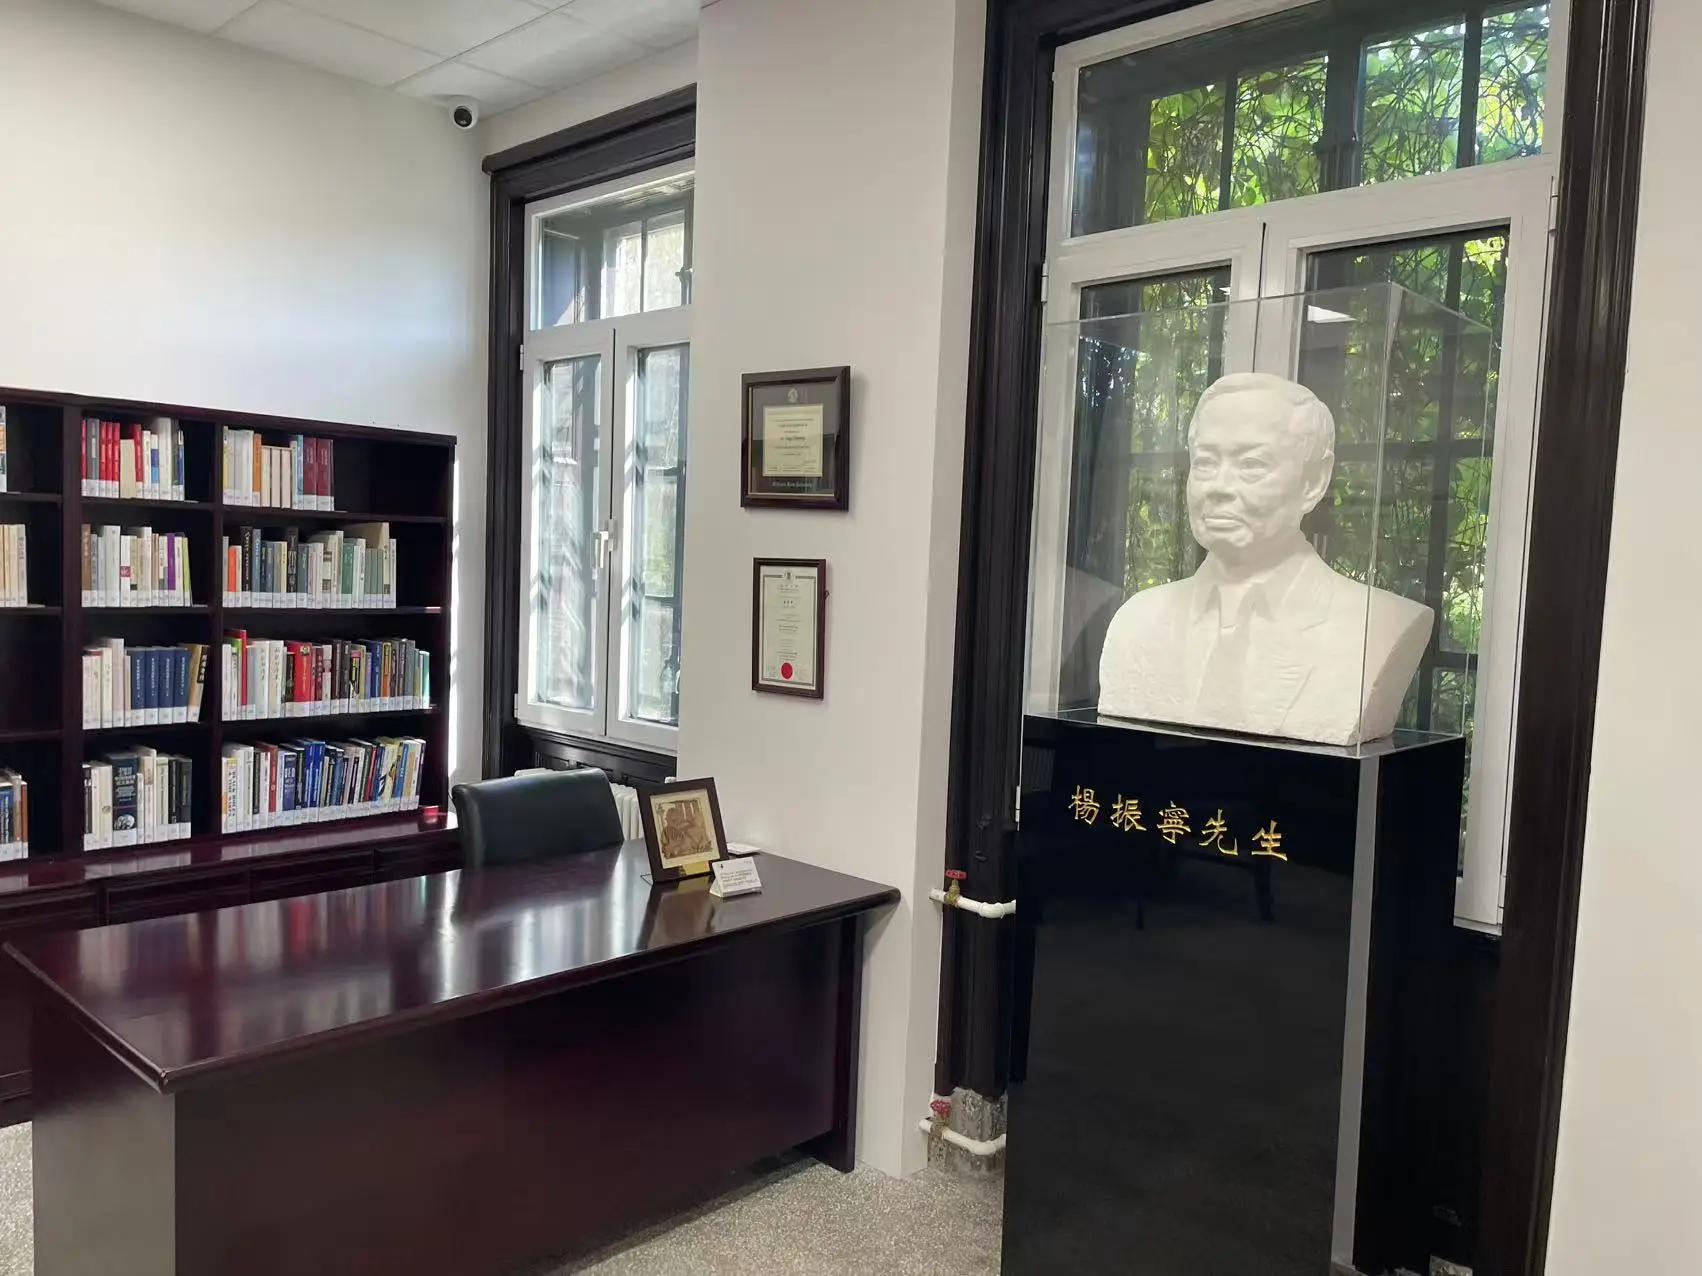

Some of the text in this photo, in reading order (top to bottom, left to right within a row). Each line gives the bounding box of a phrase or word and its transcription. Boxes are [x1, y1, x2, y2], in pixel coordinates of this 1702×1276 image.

[1068, 784, 1288, 861] 楊振寧先生
